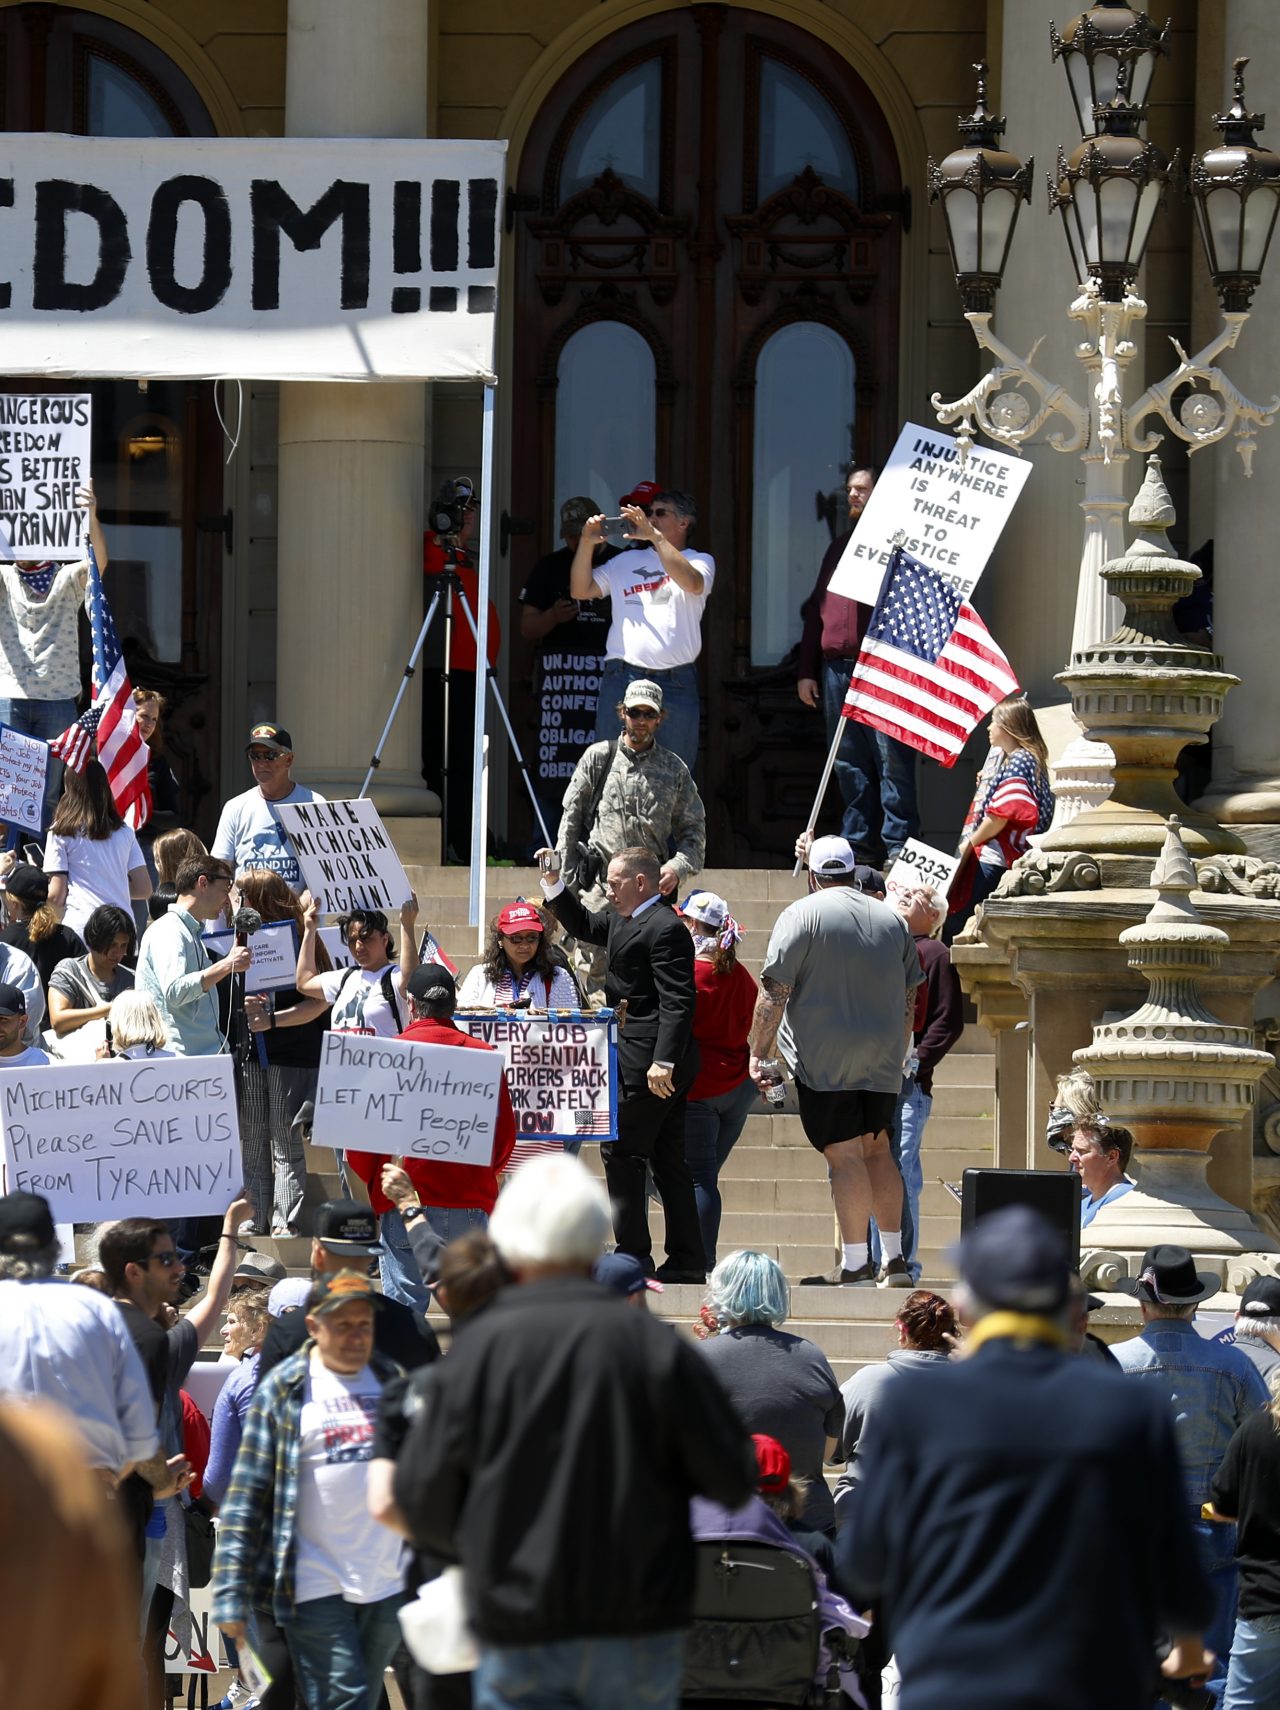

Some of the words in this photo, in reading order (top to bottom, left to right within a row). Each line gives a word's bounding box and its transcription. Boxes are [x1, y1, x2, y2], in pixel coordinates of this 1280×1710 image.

[21, 457, 81, 482] BETTER
[909, 457, 1008, 499] ANYWHERE
[34, 482, 82, 510] SAFE
[910, 477, 929, 492] IS
[948, 490, 961, 504] A
[913, 498, 980, 530] THREAT
[923, 523, 948, 541] TO
[542, 654, 605, 671] UNJUST
[542, 674, 600, 691] AUTHO
[541, 695, 598, 711] CONFE
[542, 711, 562, 727] NO
[539, 728, 596, 744] OBLIGA
[539, 745, 557, 761] OF
[294, 801, 359, 829] MAKE
[289, 826, 388, 857] MICHIGAN
[318, 853, 379, 882] WORK
[323, 878, 393, 913] AGAIN!
[469, 1022, 532, 1044] EVERY
[542, 1024, 588, 1044] JOB
[325, 1034, 424, 1072] Pharoah
[511, 1045, 603, 1067] ESSENTIAL
[129, 1066, 228, 1104] COURTS,
[396, 1069, 497, 1100] Whitmer,
[505, 1067, 564, 1088] ORKERS
[572, 1068, 608, 1088] BACK
[509, 1088, 531, 1109] ORK
[536, 1088, 601, 1110] SAFELY
[319, 1087, 361, 1105] LET
[364, 1093, 405, 1122] MI
[419, 1108, 489, 1141] People
[6, 1124, 97, 1162] Please
[109, 1117, 183, 1148] SAVE
[195, 1112, 232, 1142] US
[16, 1170, 74, 1194] FROM
[84, 1148, 233, 1201] TYRANNY!
